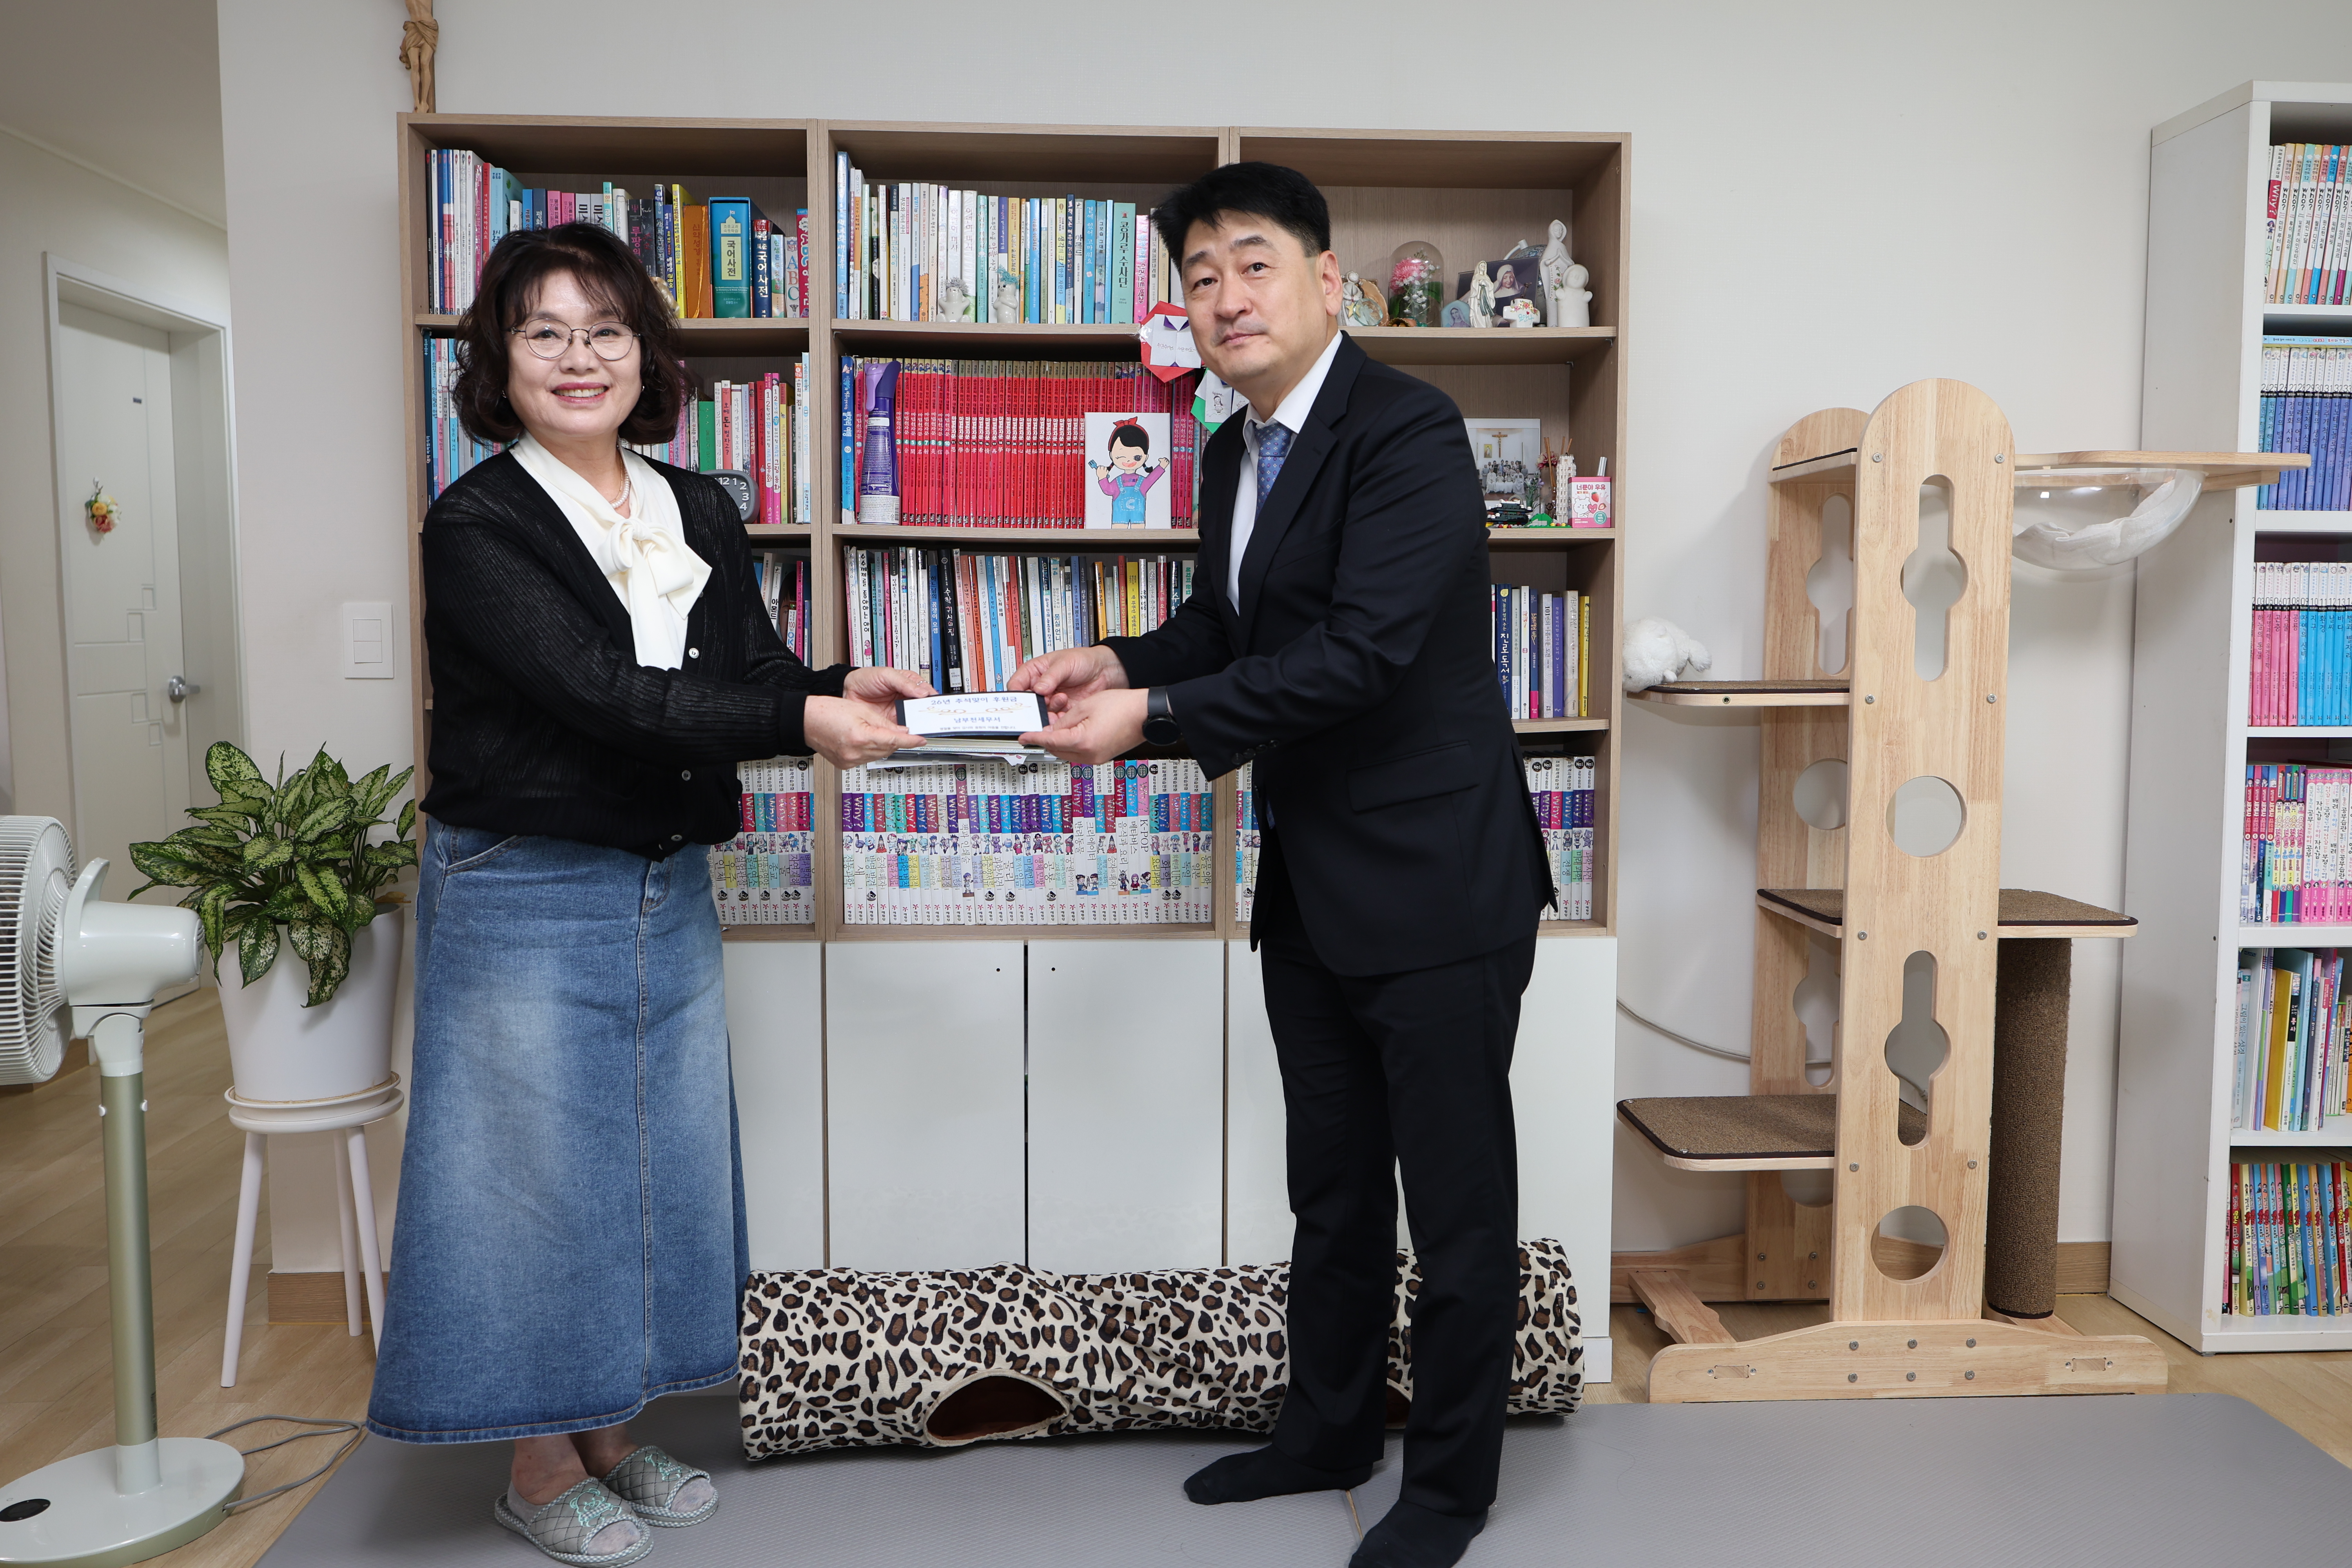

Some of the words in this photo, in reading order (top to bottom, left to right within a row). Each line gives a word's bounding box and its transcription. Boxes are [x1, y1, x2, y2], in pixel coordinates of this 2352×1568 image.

[2269, 185, 2280, 215] Why?
[900, 213, 906, 223] 자녀
[914, 214, 919, 222] 보상
[1087, 207, 1093, 220] 곁에
[900, 225, 906, 234] 사이
[1087, 223, 1093, 236] 있어
[2279, 220, 2284, 231] 마틴
[2305, 220, 2310, 231] 제인
[631, 226, 642, 256] 루팡의
[951, 237, 958, 252] 미사
[965, 236, 973, 251] 미사
[1120, 222, 1129, 253] 콩가루
[2277, 233, 2282, 244] 루터
[2303, 232, 2308, 243] 구달
[2319, 238, 2325, 249] 처칠
[727, 240, 736, 276] 국어사전
[757, 251, 768, 298] 국어사전
[1119, 256, 1128, 288] 수사단
[1138, 263, 1146, 287] 일러스트
[1138, 288, 1146, 304] 백과
[724, 403, 730, 414] 오메
[723, 416, 731, 427] 돈
[843, 412, 851, 426] 별자리
[843, 427, 851, 437] 여행
[766, 463, 772, 482] 동화
[740, 482, 747, 490] 2
[742, 493, 749, 501] 3
[739, 502, 747, 511] 4
[1186, 584, 1191, 595] 문법
[943, 588, 952, 604] 수학
[948, 627, 954, 636] 집
[1054, 613, 1060, 627] 몽실
[864, 622, 870, 632] 아이
[933, 622, 938, 633] 요셉
[2274, 615, 2281, 632] 곤충
[2292, 614, 2298, 631] 공룡
[2311, 615, 2317, 631] 지구
[2320, 615, 2326, 633] 환경
[2328, 615, 2335, 631] 날씨
[2337, 616, 2344, 631] 바다
[1055, 628, 1061, 642] 언니
[1501, 633, 1509, 654] 진로
[1545, 648, 1550, 657] 도전
[1501, 655, 1509, 673] 독서
[1073, 782, 1083, 814] Why?
[1115, 783, 1126, 814] Why?
[2332, 799, 2339, 809] 배려
[745, 796, 755, 828] Why?
[799, 795, 809, 828] Why?
[1551, 795, 1562, 824] Why?
[2307, 809, 2314, 822] 공부
[960, 823, 969, 839] 책과
[1118, 821, 1128, 846] 음식과
[1129, 821, 1138, 855] 메타버스
[1140, 819, 1149, 852] K-POP
[1086, 822, 1096, 861] 크리에이터
[960, 840, 971, 864] 인쇄술
[1119, 849, 1129, 864] 요리
[715, 859, 726, 881] 인체
[725, 860, 736, 882] 우주
[769, 862, 779, 880] 종교
[855, 866, 865, 875] 새
[1004, 861, 1014, 881] 물리
[1044, 861, 1055, 883] 공룡
[1161, 860, 1171, 882] 화학
[1182, 862, 1191, 878] 독일
[1192, 863, 1201, 879] 일본
[2239, 1025, 2247, 1038] 있는
[2238, 1040, 2246, 1054] 성경
